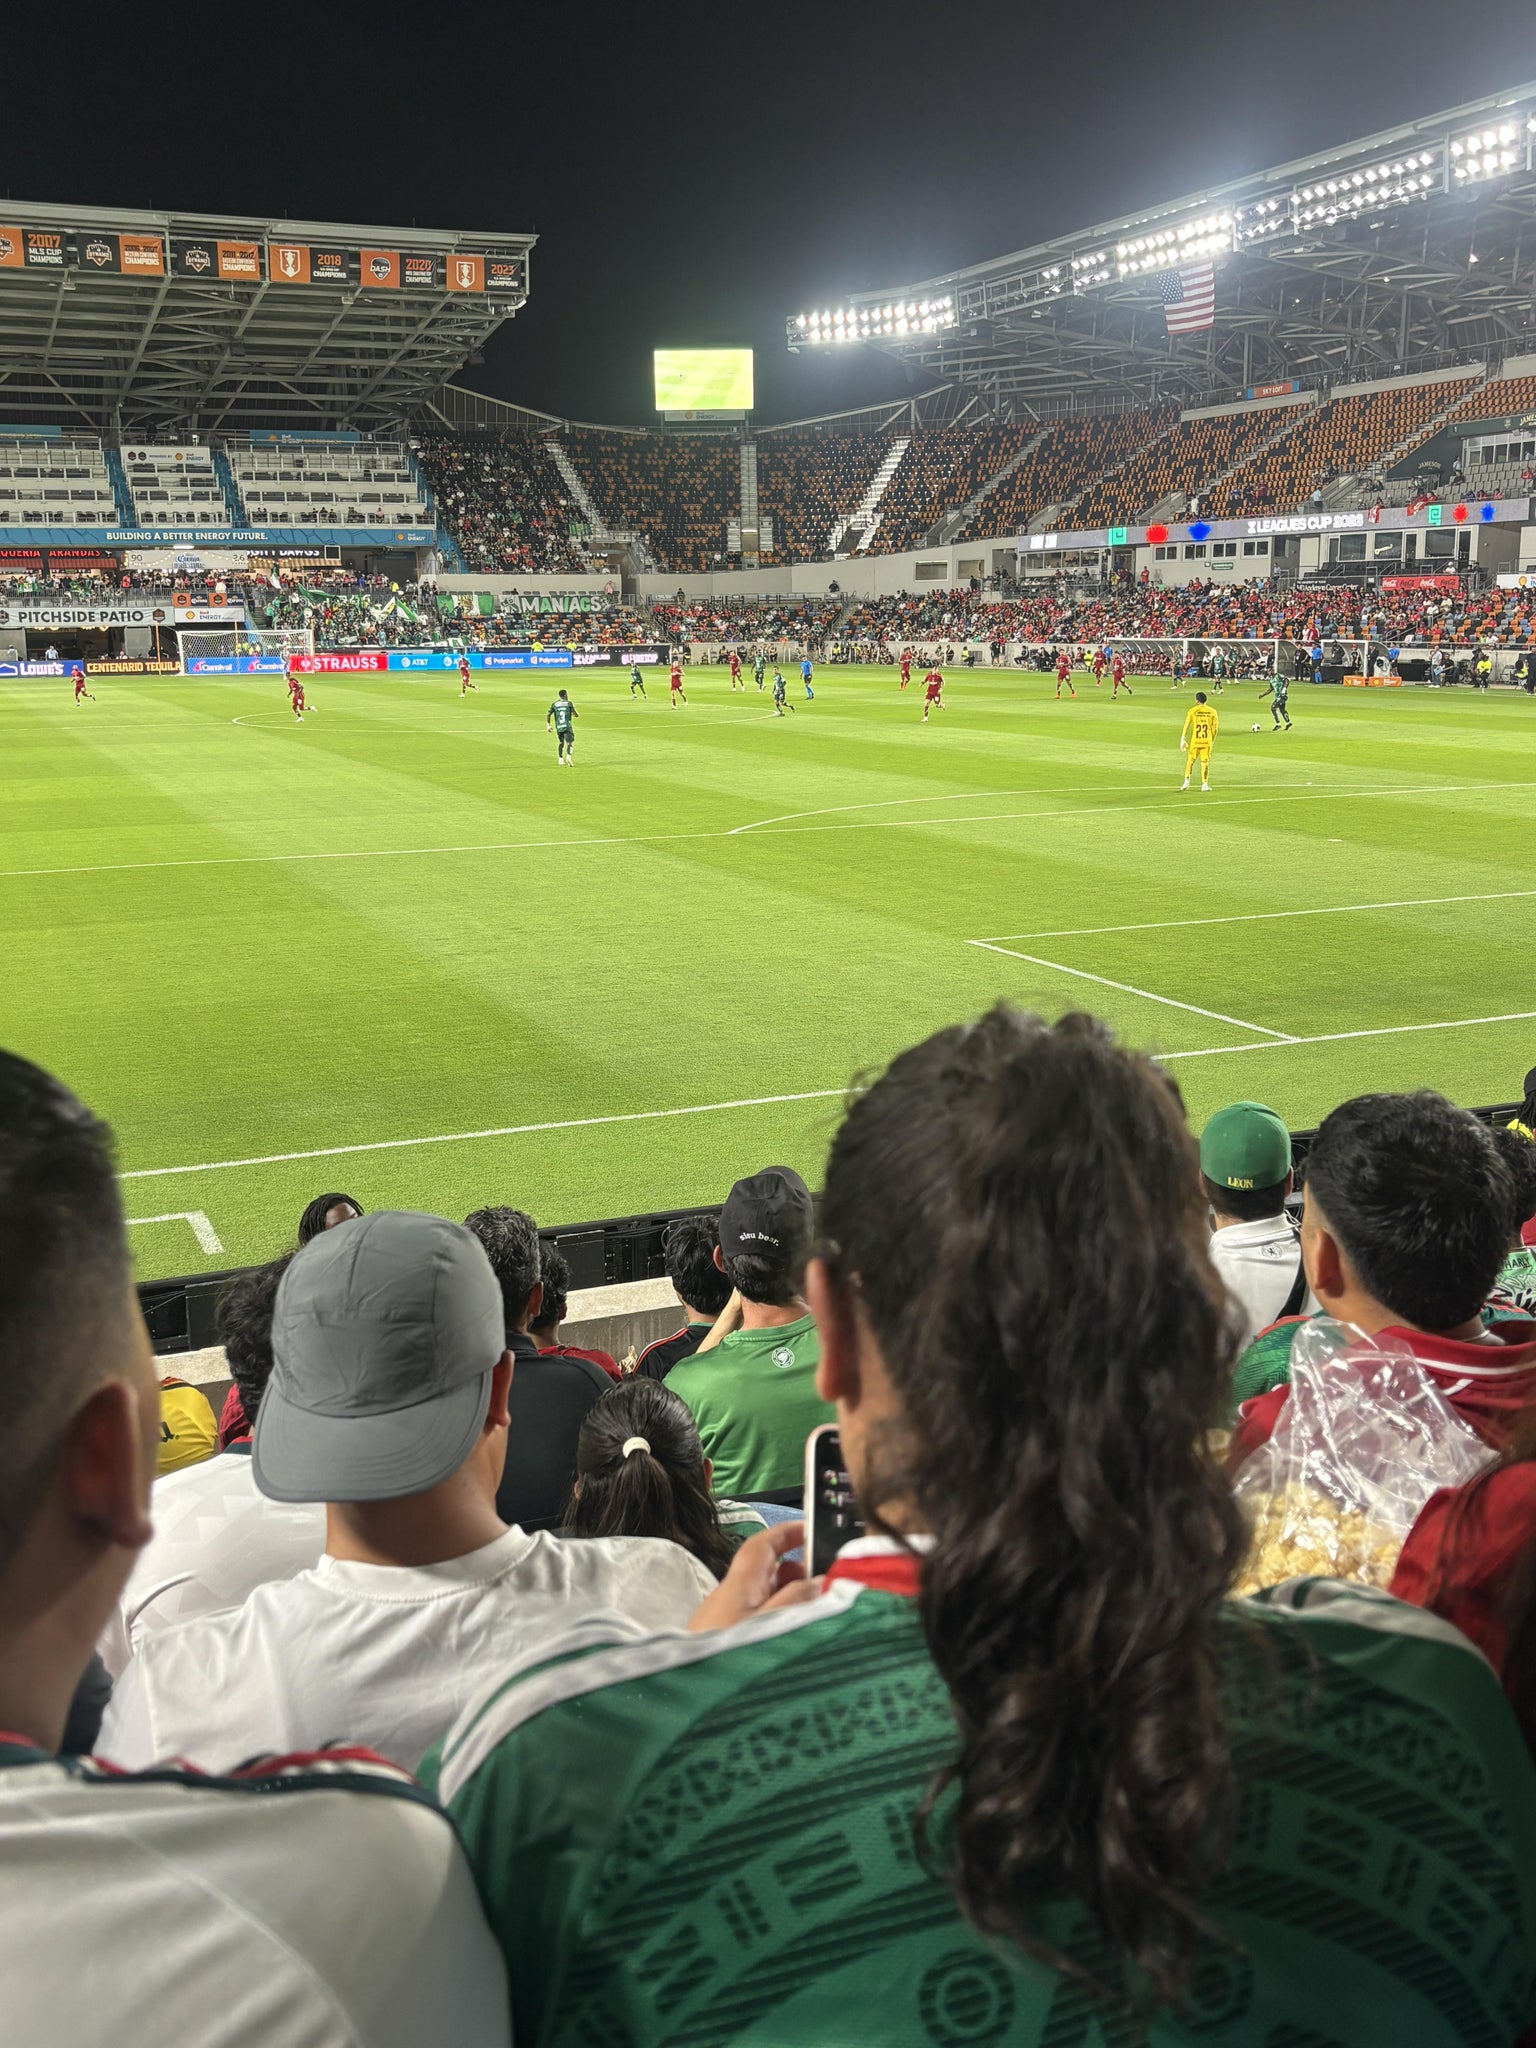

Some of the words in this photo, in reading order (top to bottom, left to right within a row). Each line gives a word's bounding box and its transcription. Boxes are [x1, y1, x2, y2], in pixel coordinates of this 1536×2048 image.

[28, 234, 61, 248] 2007
[46, 248, 62, 256] CUP
[222, 250, 236, 258] 2011
[29, 255, 63, 264] CHAMPIONS
[125, 257, 160, 266] CHAMPIONS
[317, 254, 342, 266] 2018
[223, 264, 256, 272] CHAMPIONS
[370, 265, 391, 273] DASH
[405, 258, 432, 271] 2020
[490, 264, 515, 275] 2023
[313, 270, 347, 279] CHAMPIONS
[405, 276, 432, 284] CHAMPIONS
[487, 279, 519, 287] CHAMPIONS
[1272, 386, 1283, 394] LOFT
[1257, 517, 1306, 533] LEAGUES
[1307, 515, 1332, 530] CUP
[106, 532, 152, 540] BUILDING
[153, 532, 160, 540] A
[162, 532, 194, 540] BETTER
[195, 532, 231, 541] ENERGY
[232, 532, 268, 540] FUTURE.
[131, 554, 143, 562] 90
[521, 597, 601, 613] MANIACS
[18, 611, 96, 623] PITCHSIDE
[100, 610, 144, 622] PATIO
[313, 658, 378, 669] STRAUSS
[411, 658, 429, 666] AT&T
[493, 657, 524, 665] Polymarket
[538, 656, 569, 664] Polymarket
[86, 662, 144, 673] CENTENARIO
[145, 661, 182, 672] TEQUILA
[202, 663, 233, 672] Carnival
[559, 711, 566, 724] 3
[1195, 724, 1209, 739] 23
[1227, 1176, 1254, 1189] LEON
[1503, 1256, 1530, 1270] HARLY
